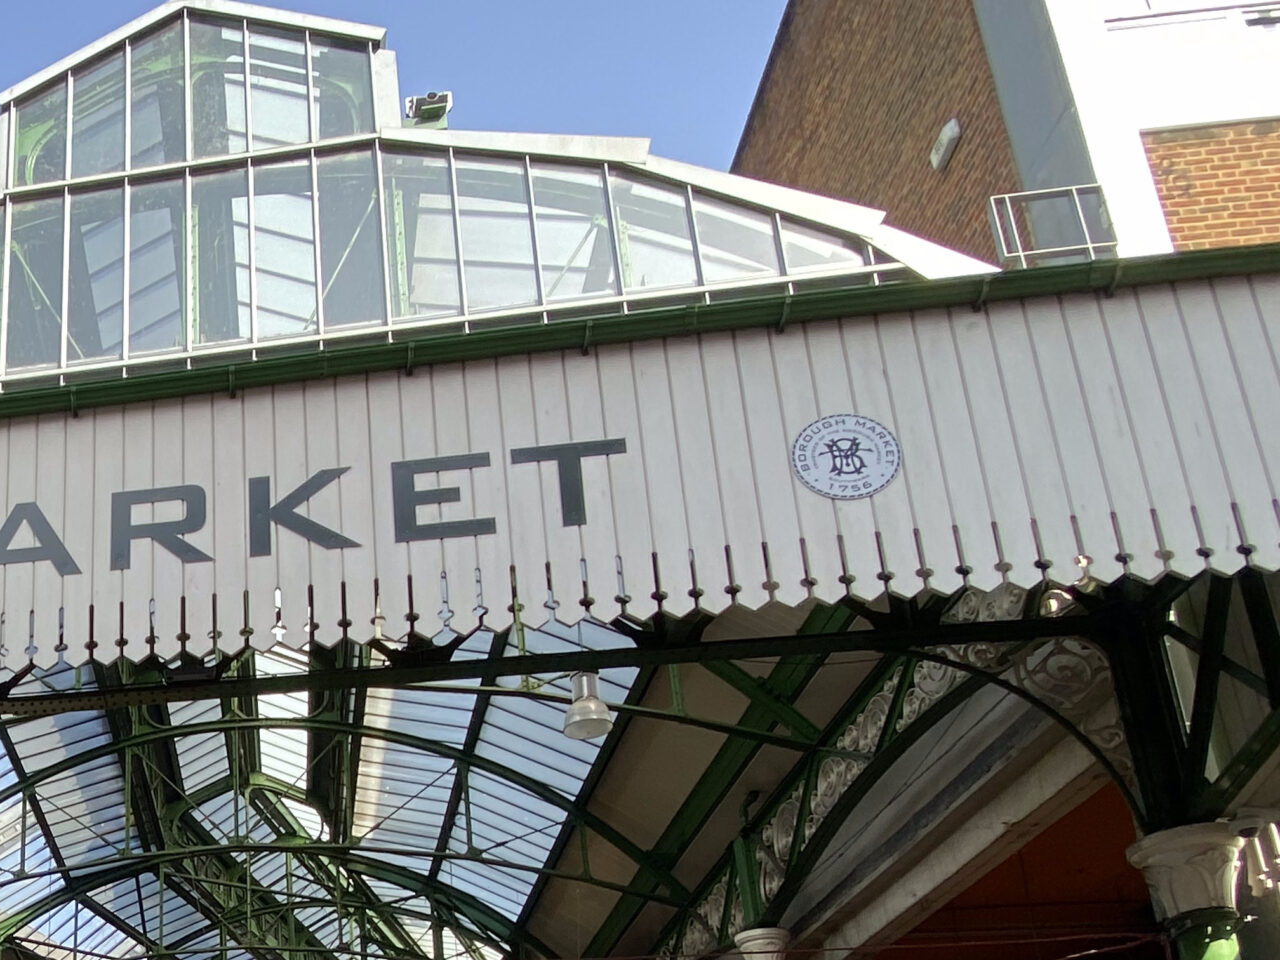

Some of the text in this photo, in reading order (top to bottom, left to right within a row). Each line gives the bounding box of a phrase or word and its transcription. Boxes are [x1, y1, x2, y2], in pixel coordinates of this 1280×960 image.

[798, 419, 846, 472] BOROUGH
[854, 419, 895, 467] MARKET
[829, 481, 873, 493] 1756
